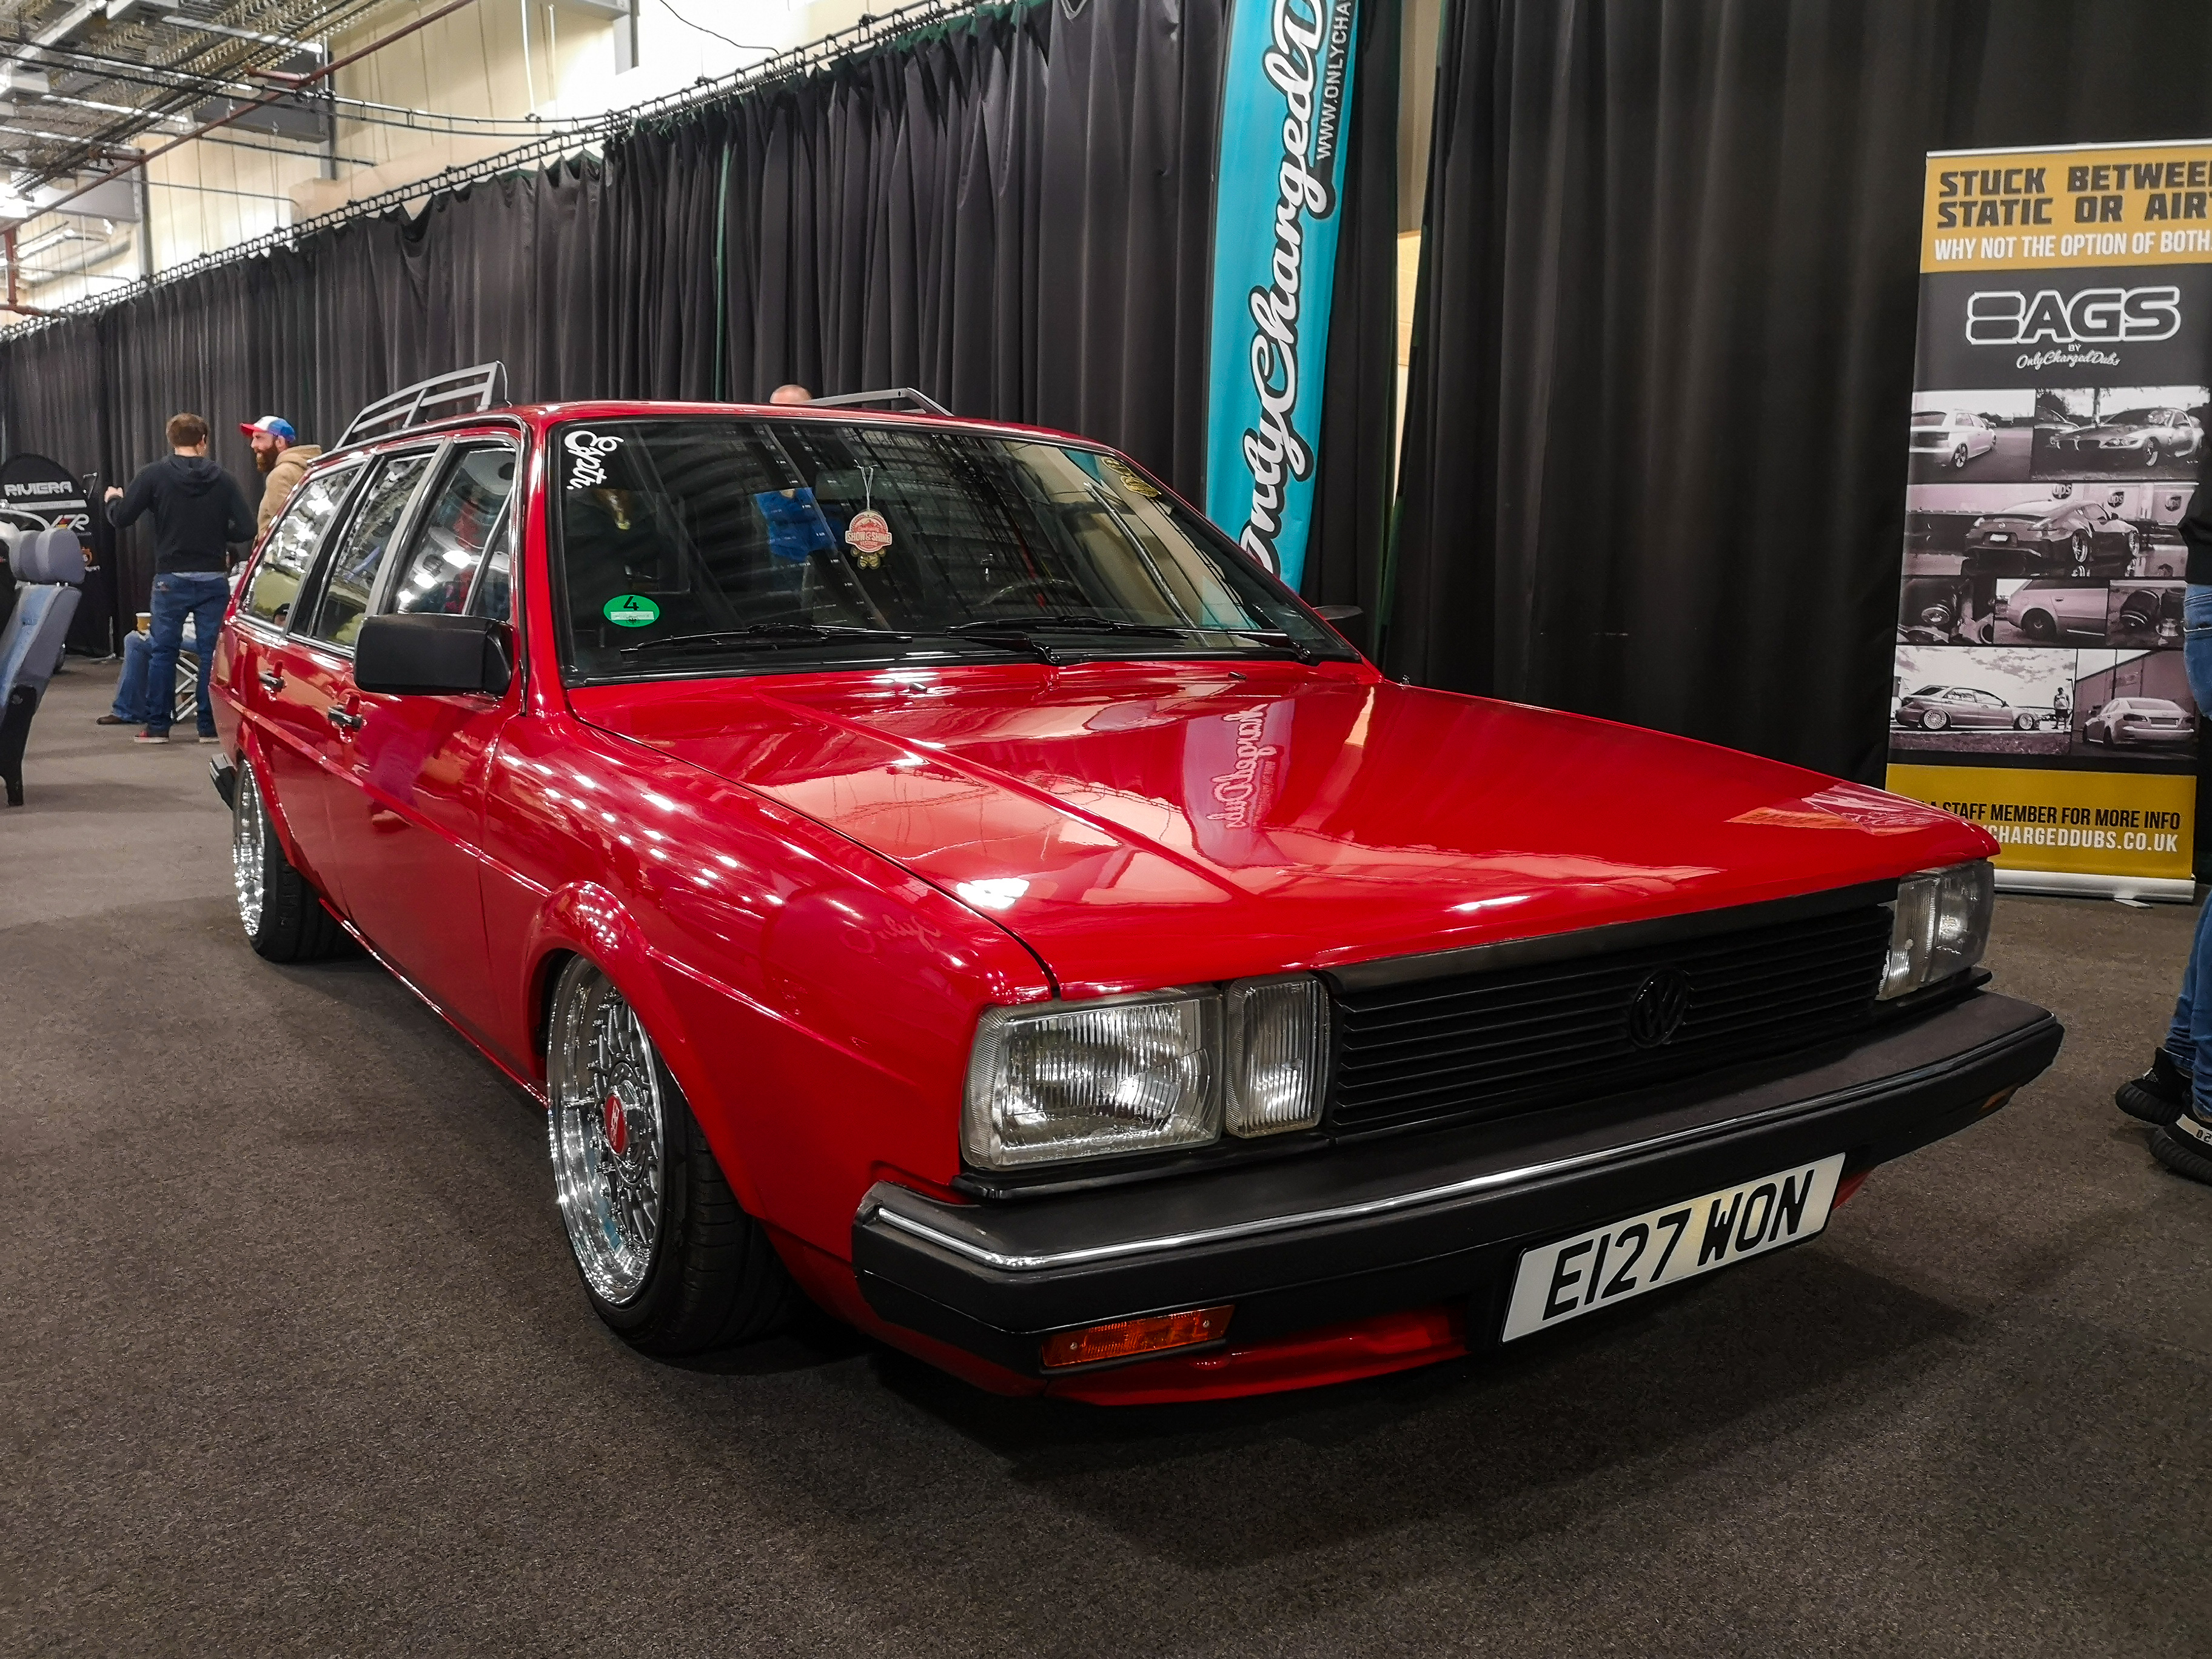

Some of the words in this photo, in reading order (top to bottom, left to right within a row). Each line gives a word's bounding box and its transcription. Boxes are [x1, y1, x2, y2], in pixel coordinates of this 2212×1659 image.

[1316, 0, 1352, 159] WWW.ONLYCHA
[1939, 168, 2046, 198] STUCK
[2067, 161, 2212, 193] BETWEE
[1937, 197, 2053, 229] STATIC
[2074, 195, 2123, 224] OR
[2144, 191, 2212, 221] AIR
[1935, 238, 1976, 261] WHY
[1980, 236, 2017, 259] NOT
[2021, 235, 2056, 258] THE
[2060, 233, 2127, 256] OPTION
[2132, 231, 2155, 255] OF
[2068, 344, 2082, 352] BY
[4, 481, 73, 497] RIVIERA
[623, 596, 640, 611] 4
[1943, 802, 1988, 821] STAFF
[1991, 804, 2058, 825] MEMBER
[2061, 807, 2091, 826] FOR
[2095, 809, 2140, 829] MORE
[2144, 811, 2181, 831] INFO
[1983, 825, 2179, 853] CHARGEDDUBS.CO.UK
[1542, 1208, 1692, 1321] E127
[1697, 1169, 1815, 1267] WON
